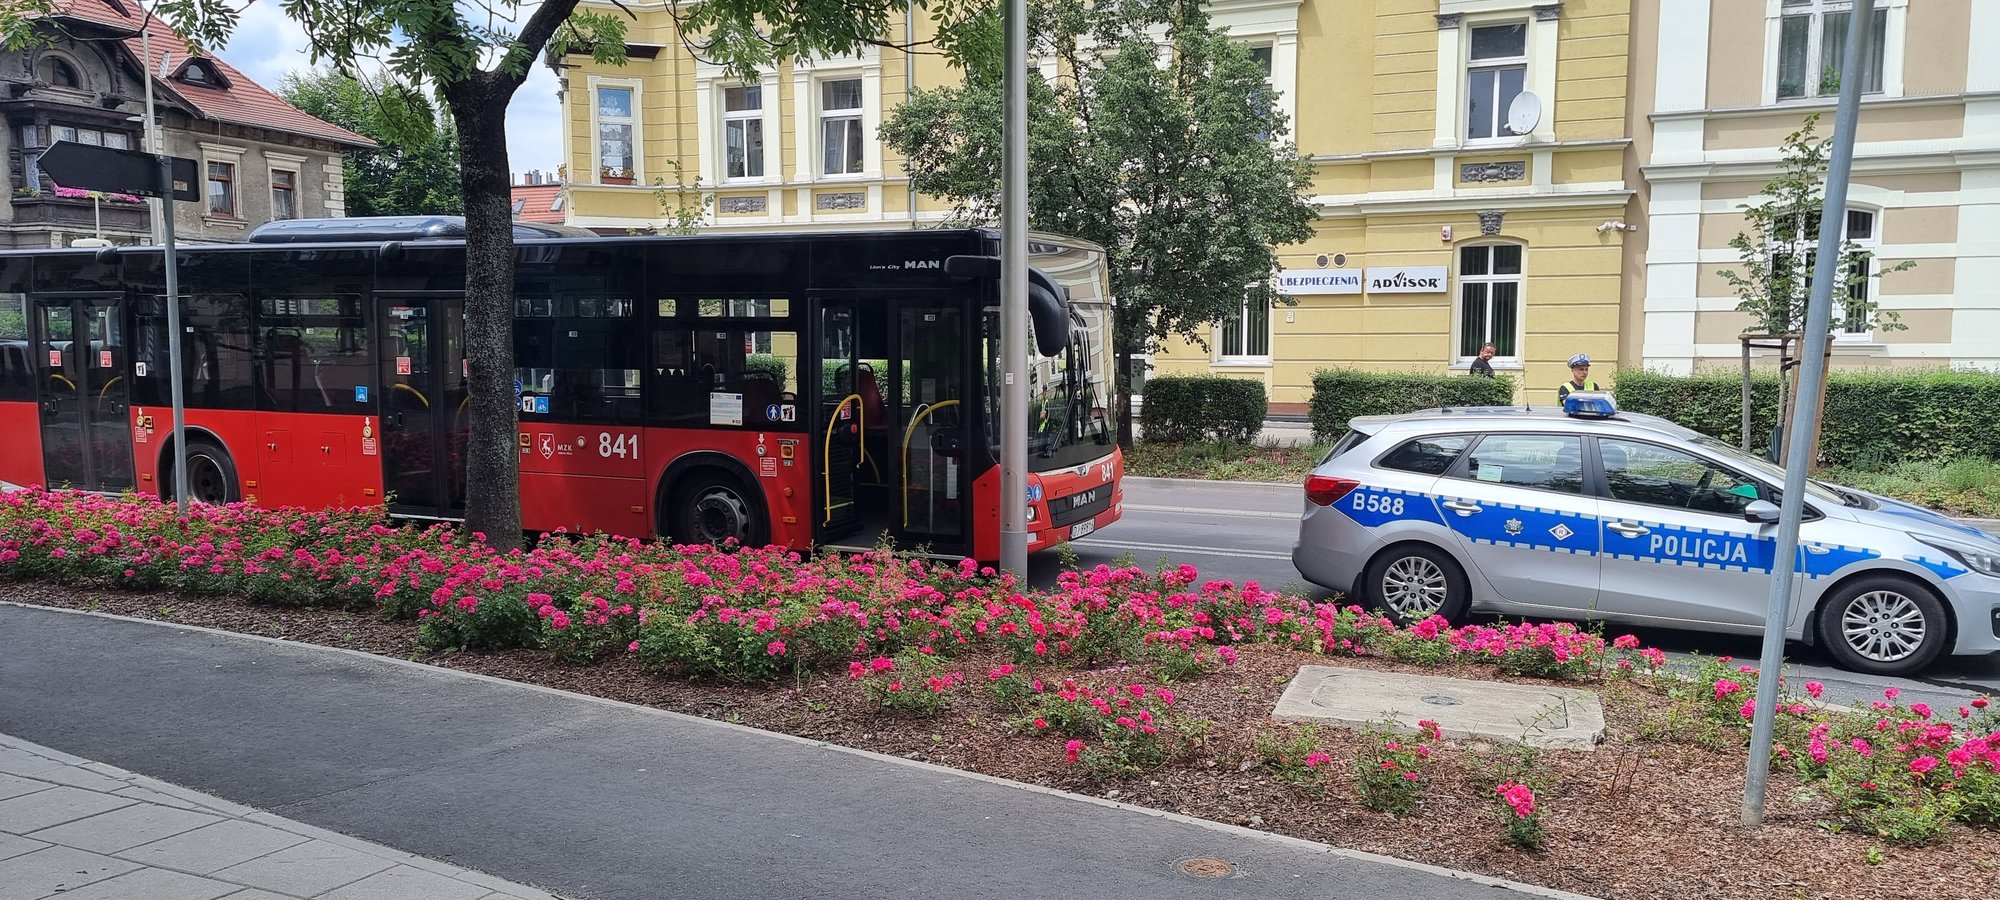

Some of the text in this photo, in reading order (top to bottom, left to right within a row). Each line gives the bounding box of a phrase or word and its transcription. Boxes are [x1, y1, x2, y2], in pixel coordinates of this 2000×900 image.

[904, 260, 940, 269] MAN
[1279, 276, 1359, 286] UBEZPIECZENIA
[599, 432, 638, 459] 841
[1101, 462, 1114, 481] 841
[1073, 490, 1095, 508] MAN
[1352, 492, 1405, 515] B588
[1649, 534, 1747, 563] POLICJA
